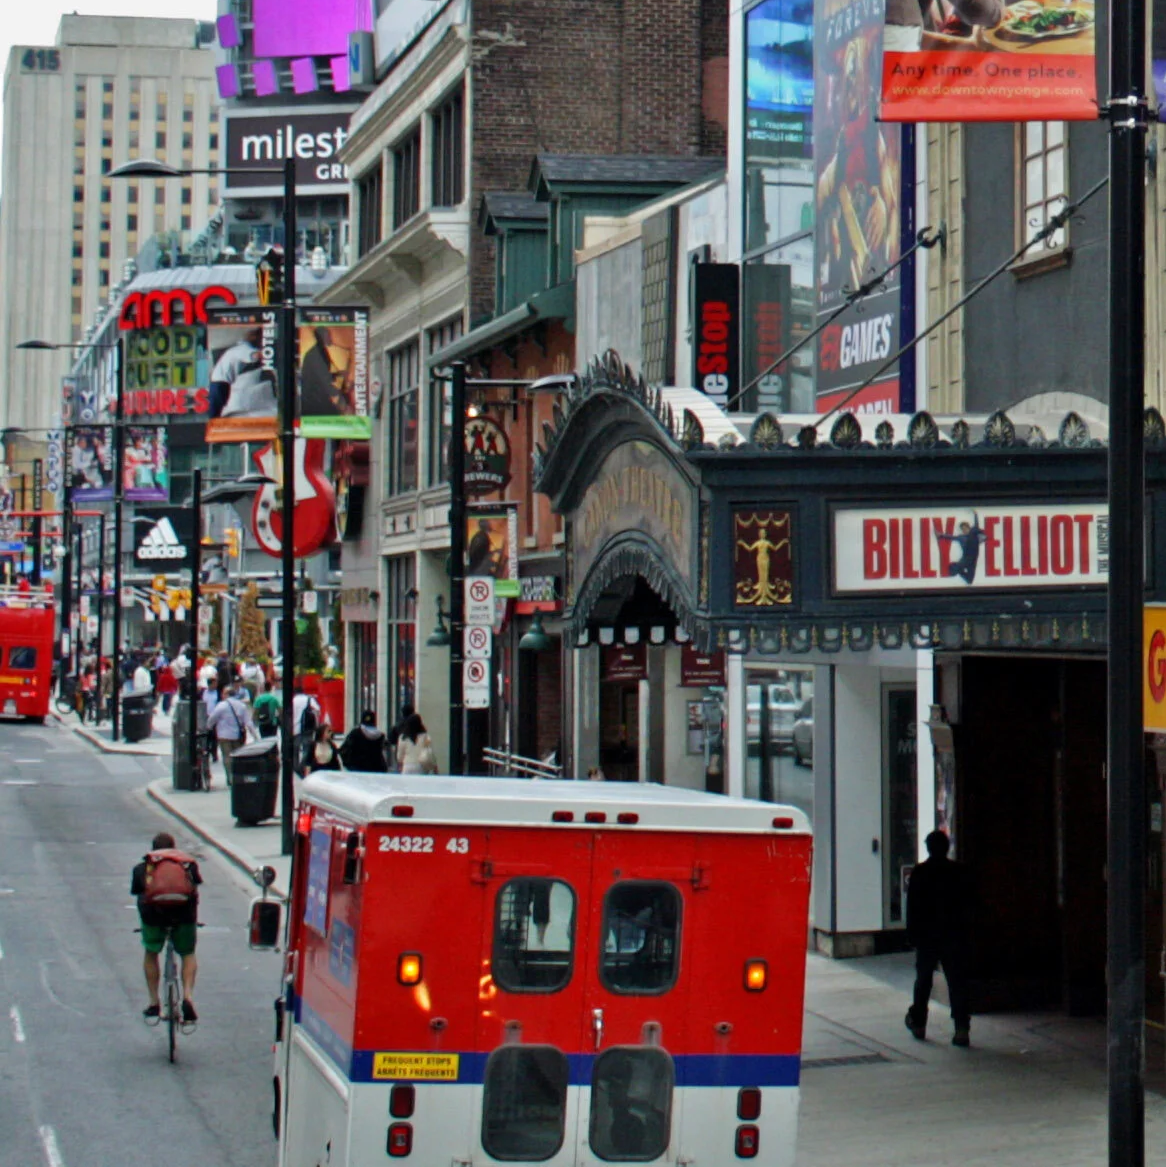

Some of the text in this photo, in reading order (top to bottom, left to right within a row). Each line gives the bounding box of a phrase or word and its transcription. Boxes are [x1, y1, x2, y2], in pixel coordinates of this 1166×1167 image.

[892, 63, 1083, 80] Any time. One place.
[892, 85, 1084, 98] www.downtownyonge.com
[261, 311, 276, 371] HOTELS
[840, 313, 893, 369] GAMES
[354, 310, 368, 417] ENTERTAINMENT
[862, 514, 1094, 580] BILLY ELLIOT
[379, 835, 469, 854] 24322 43
[382, 1055, 452, 1066] FREQUENT STOPS
